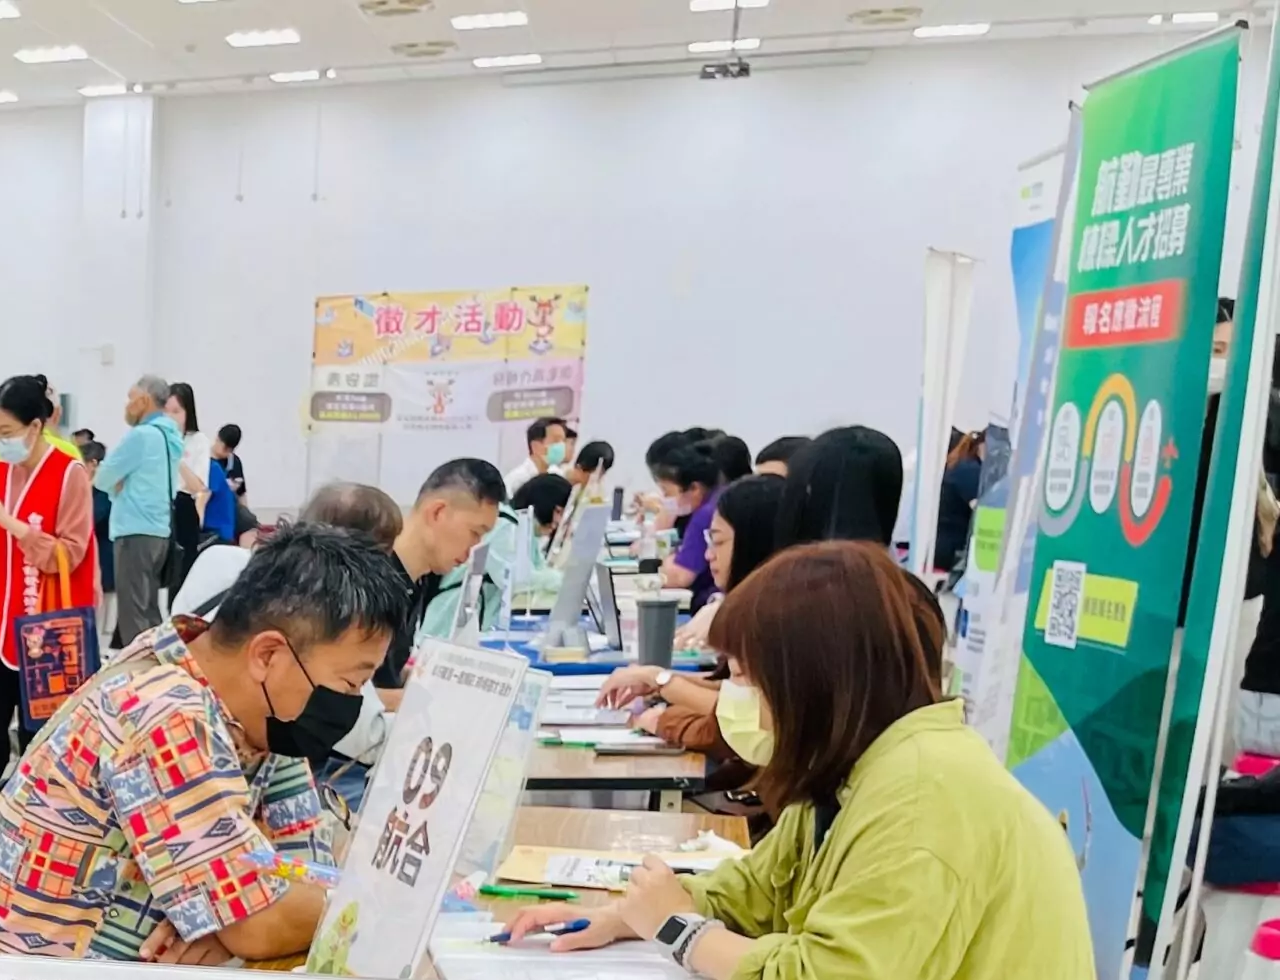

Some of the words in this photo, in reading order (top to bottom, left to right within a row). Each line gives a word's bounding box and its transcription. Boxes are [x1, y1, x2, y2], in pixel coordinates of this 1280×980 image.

[375, 302, 527, 336] 徵才活動
[403, 736, 453, 811] 09
[371, 805, 432, 889] 航合
